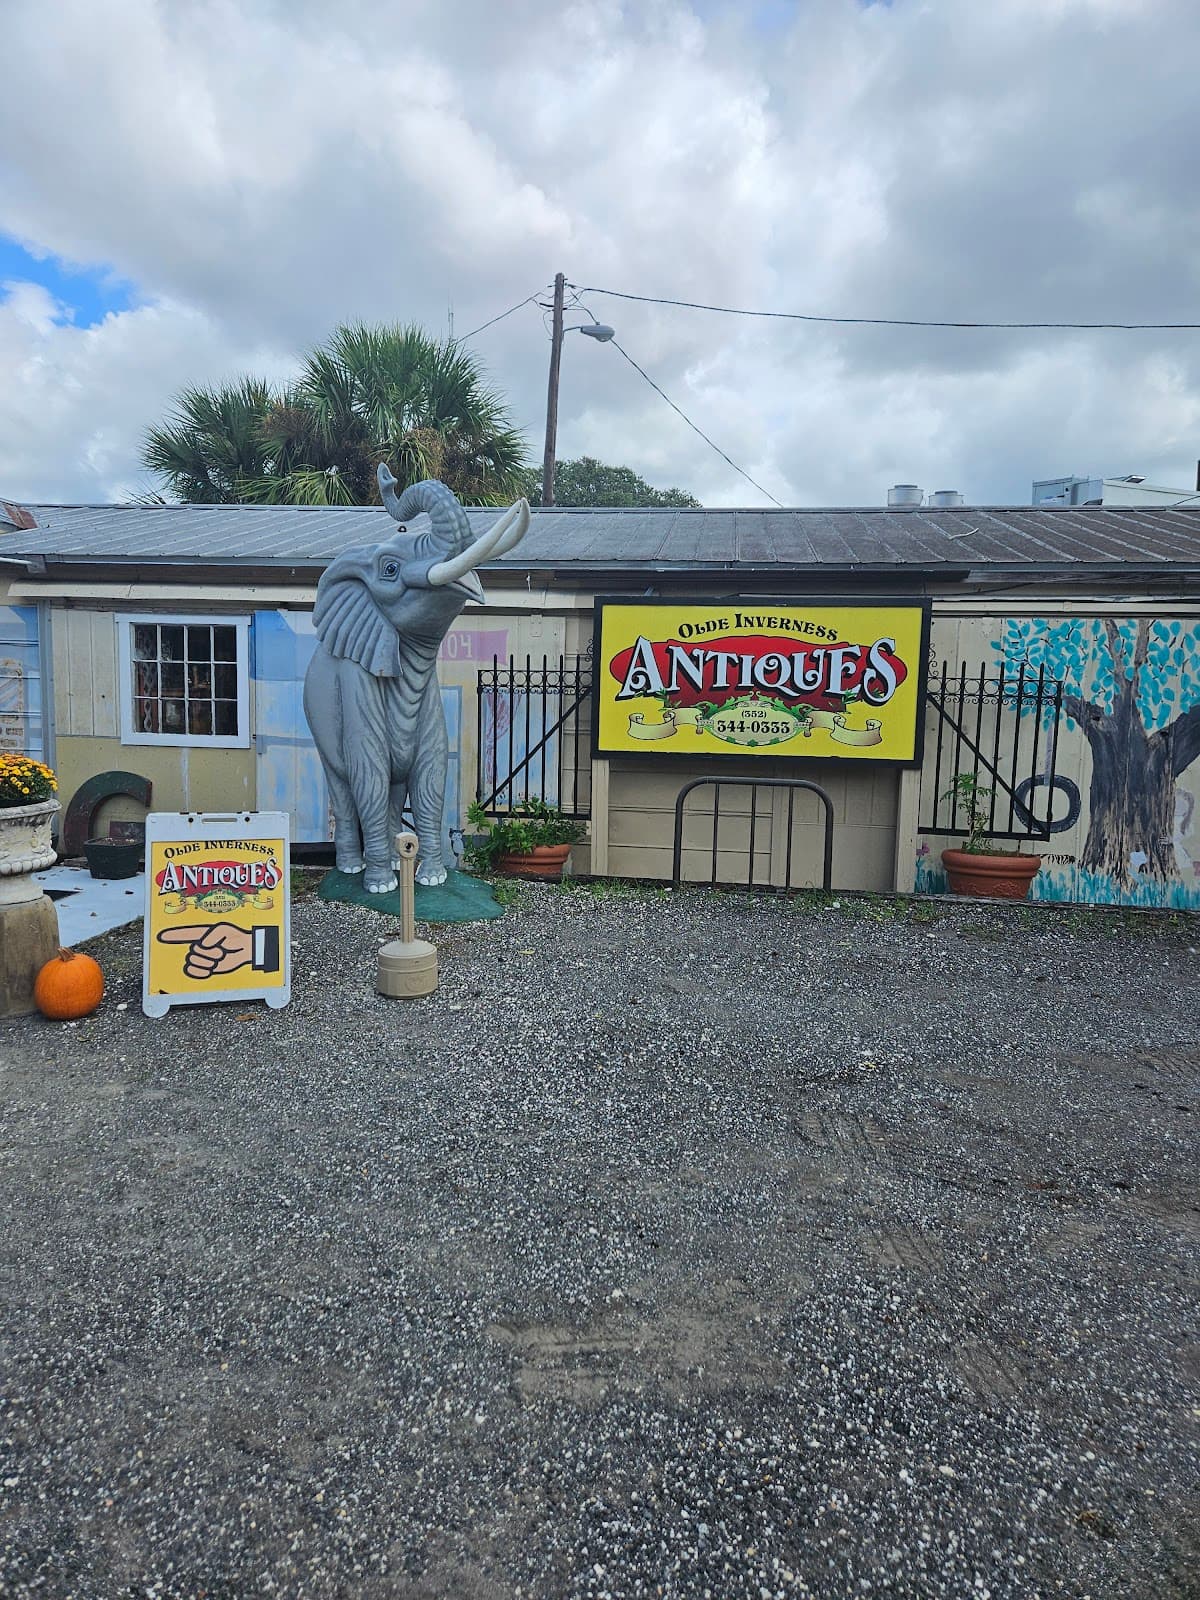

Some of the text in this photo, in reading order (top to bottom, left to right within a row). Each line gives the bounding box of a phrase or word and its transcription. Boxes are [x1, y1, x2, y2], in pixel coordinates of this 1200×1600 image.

[678, 613, 839, 642] OLDE INVERNESS
[615, 635, 897, 706] ANTIQUES
[741, 710, 767, 718] (352)
[717, 720, 790, 733] 344-0333
[164, 842, 201, 859] OLDE
[158, 856, 279, 896] ANTIQUES
